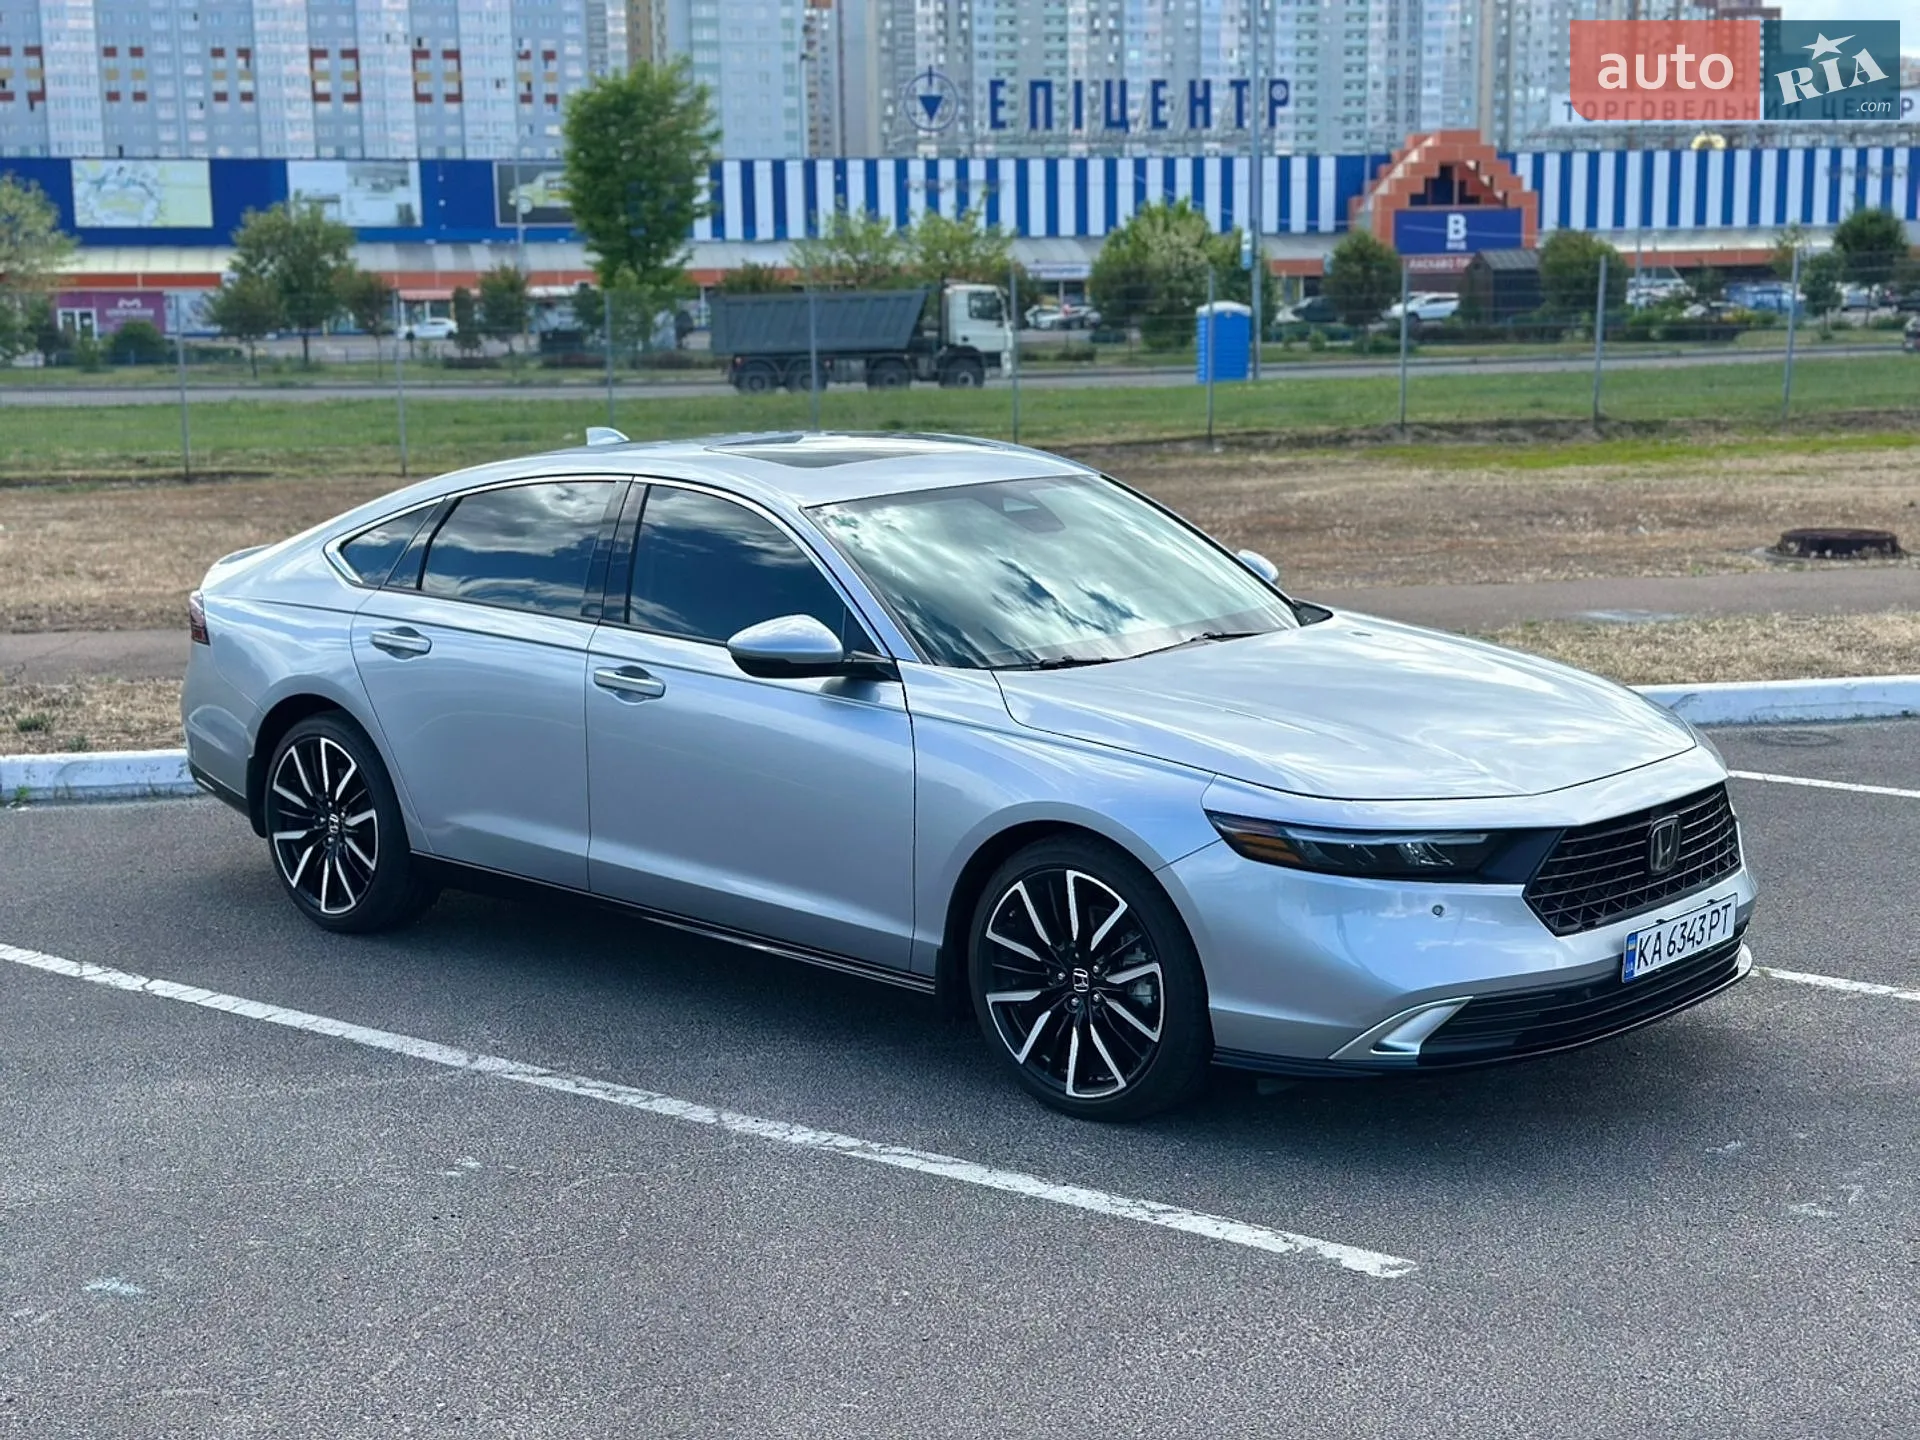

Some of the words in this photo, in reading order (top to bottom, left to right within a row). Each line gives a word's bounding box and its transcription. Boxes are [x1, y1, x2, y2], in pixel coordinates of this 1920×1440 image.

[989, 79, 1289, 133] ЕПІЦЕНТР
[1637, 931, 1662, 970] KA
[1667, 914, 1707, 957] 6343
[1708, 903, 1732, 941] PT
